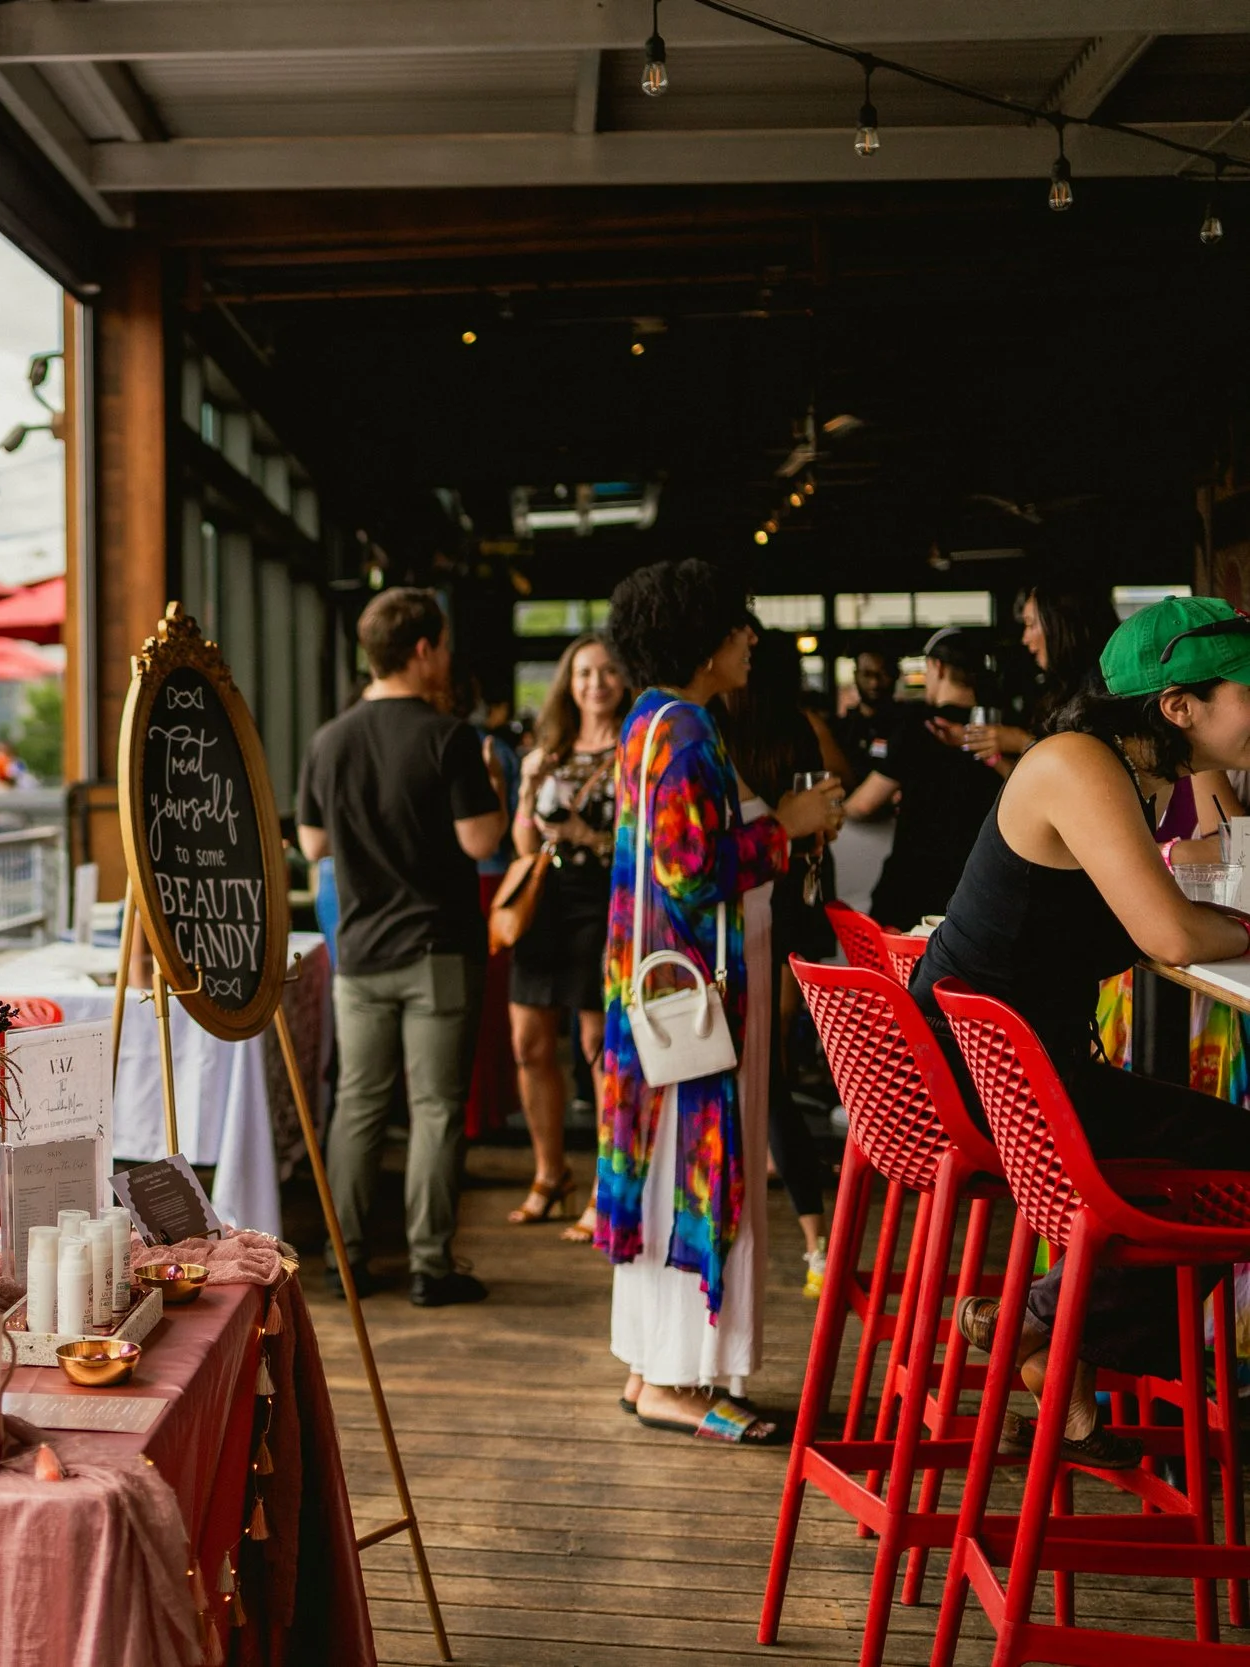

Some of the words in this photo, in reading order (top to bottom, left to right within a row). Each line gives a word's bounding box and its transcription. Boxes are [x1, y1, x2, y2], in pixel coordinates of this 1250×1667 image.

[148, 724, 219, 794] Treat
[150, 772, 240, 862] yourself
[174, 844, 190, 865] to
[195, 848, 228, 867] some
[154, 871, 263, 923] BEAUTY
[174, 920, 261, 972] CANDY
